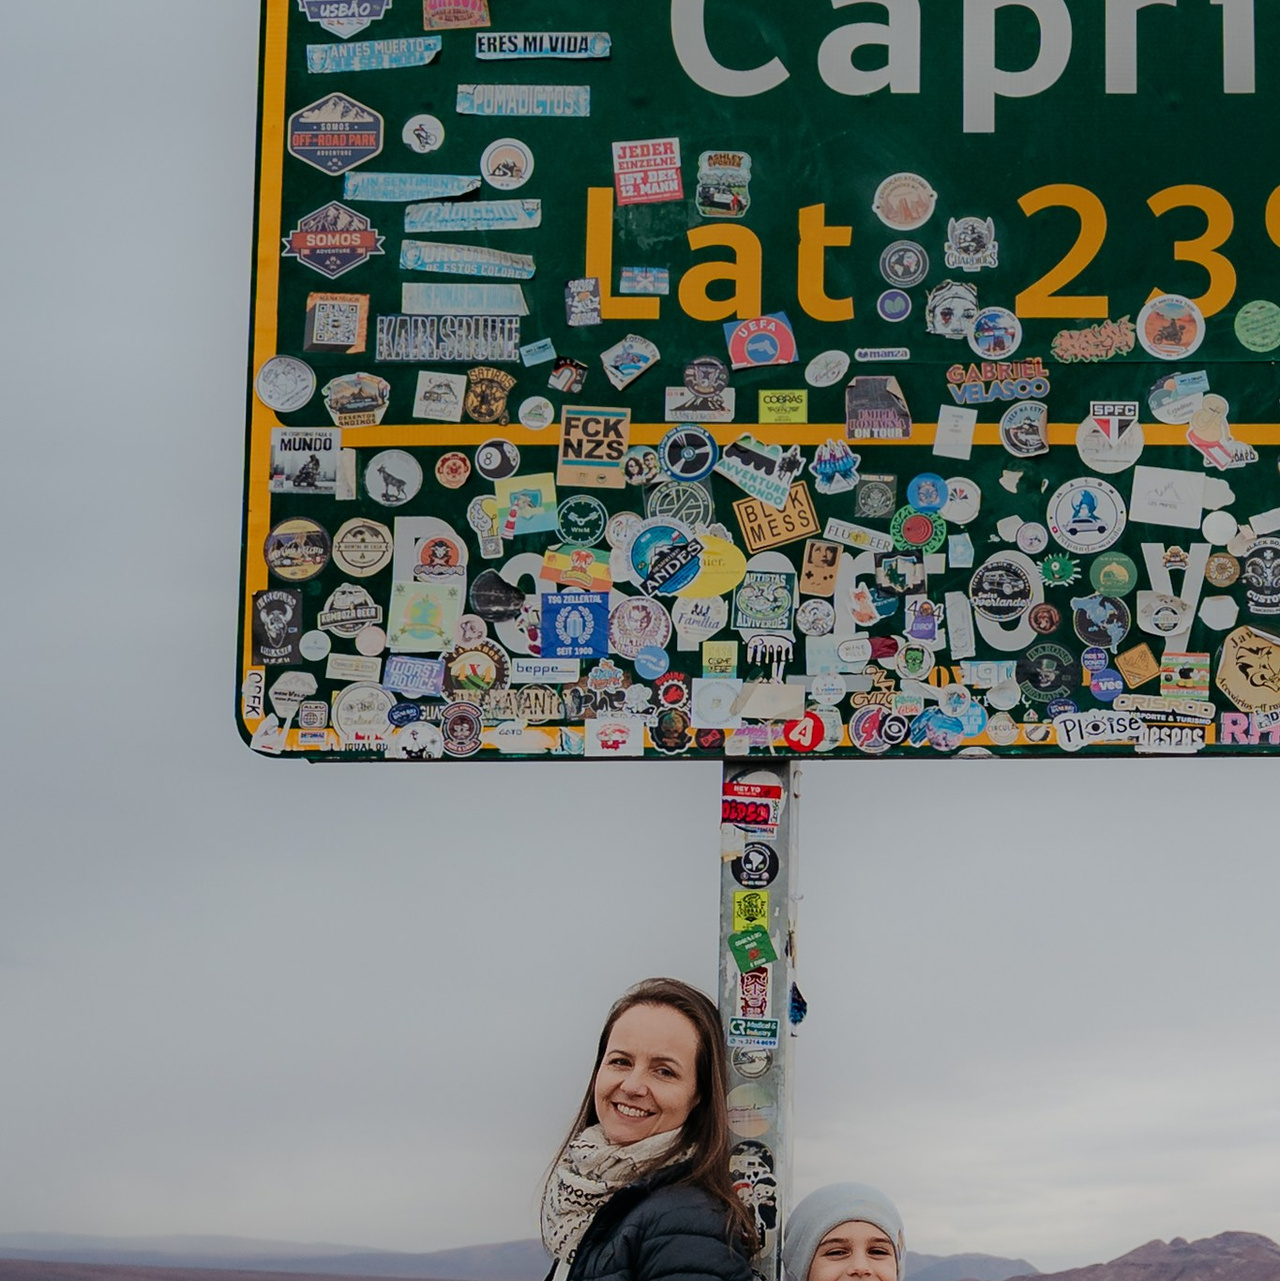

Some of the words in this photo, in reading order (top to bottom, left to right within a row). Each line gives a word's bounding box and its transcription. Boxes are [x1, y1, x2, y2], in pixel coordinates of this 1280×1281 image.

[330, 43, 372, 58] ANTES
[374, 39, 426, 56] MUERTO
[477, 33, 518, 54] ERES
[523, 34, 545, 53] MI
[549, 35, 590, 53] VIDA
[473, 86, 576, 115] PUMADICTOS
[320, 123, 351, 132] SOMOS
[292, 133, 346, 147] OFF-ROAD
[348, 133, 376, 147] PARK
[617, 142, 675, 160] JEDER
[618, 158, 676, 170] EINZELNE
[620, 171, 643, 185] IST
[646, 168, 677, 183] DER
[639, 181, 679, 195] MANN
[305, 233, 362, 246] SOMOS
[586, 187, 855, 322] Lat
[440, 263, 477, 275] ESTOS
[480, 266, 529, 278] COLORES
[738, 320, 778, 339] UEFA
[376, 315, 521, 362] KARLSRUHE
[947, 358, 1050, 384] GABRIEL
[948, 378, 1050, 404] VELASCO
[763, 394, 803, 405] COBRAS
[1093, 404, 1136, 417] SPFC
[564, 417, 625, 439] FCK
[854, 428, 870, 438] ON
[871, 427, 903, 438] TOUR
[280, 436, 333, 452] MUNDO
[562, 439, 625, 461] NZS
[717, 459, 788, 495] AVVENTURE
[738, 480, 783, 507] MONDO
[748, 510, 810, 544] MESS
[1245, 539, 1269, 553] BLACK
[644, 539, 704, 594] ANDES
[744, 571, 787, 586] AUTISTAS
[548, 595, 562, 604] TSG
[563, 593, 602, 605] ZELLERTAL
[972, 595, 1032, 608] Overlander
[737, 613, 788, 629] ALVIVERDES
[556, 646, 572, 655] SEIT
[573, 646, 594, 655] 1900
[390, 658, 440, 678] WORST
[516, 662, 560, 676] beppe
[389, 672, 438, 690] ADVICE
[1116, 695, 1214, 716] CRISROD
[1175, 714, 1212, 724] TURISMO
[733, 785, 749, 793] HEY
[750, 786, 762, 794] YO
[746, 1021, 770, 1030] Medical
[746, 1028, 772, 1038] Industry
